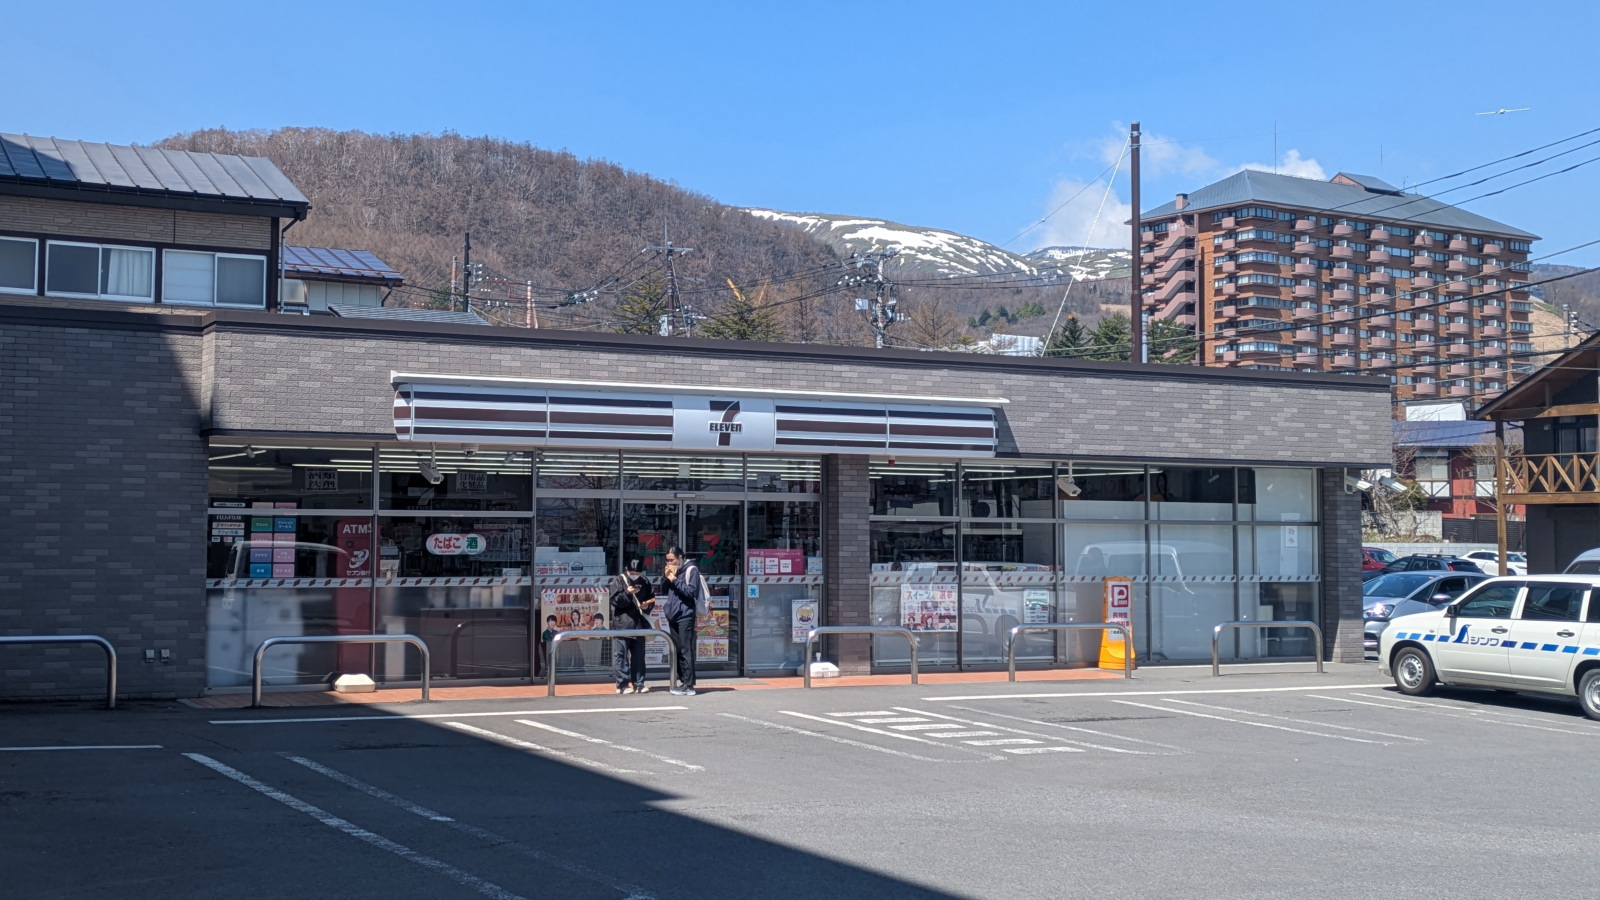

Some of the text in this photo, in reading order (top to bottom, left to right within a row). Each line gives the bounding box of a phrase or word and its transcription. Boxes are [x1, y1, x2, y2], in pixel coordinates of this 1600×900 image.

[342, 524, 368, 534] ATM
[433, 536, 479, 549] たばこ 酒
[1470, 636, 1500, 647] シンワ
